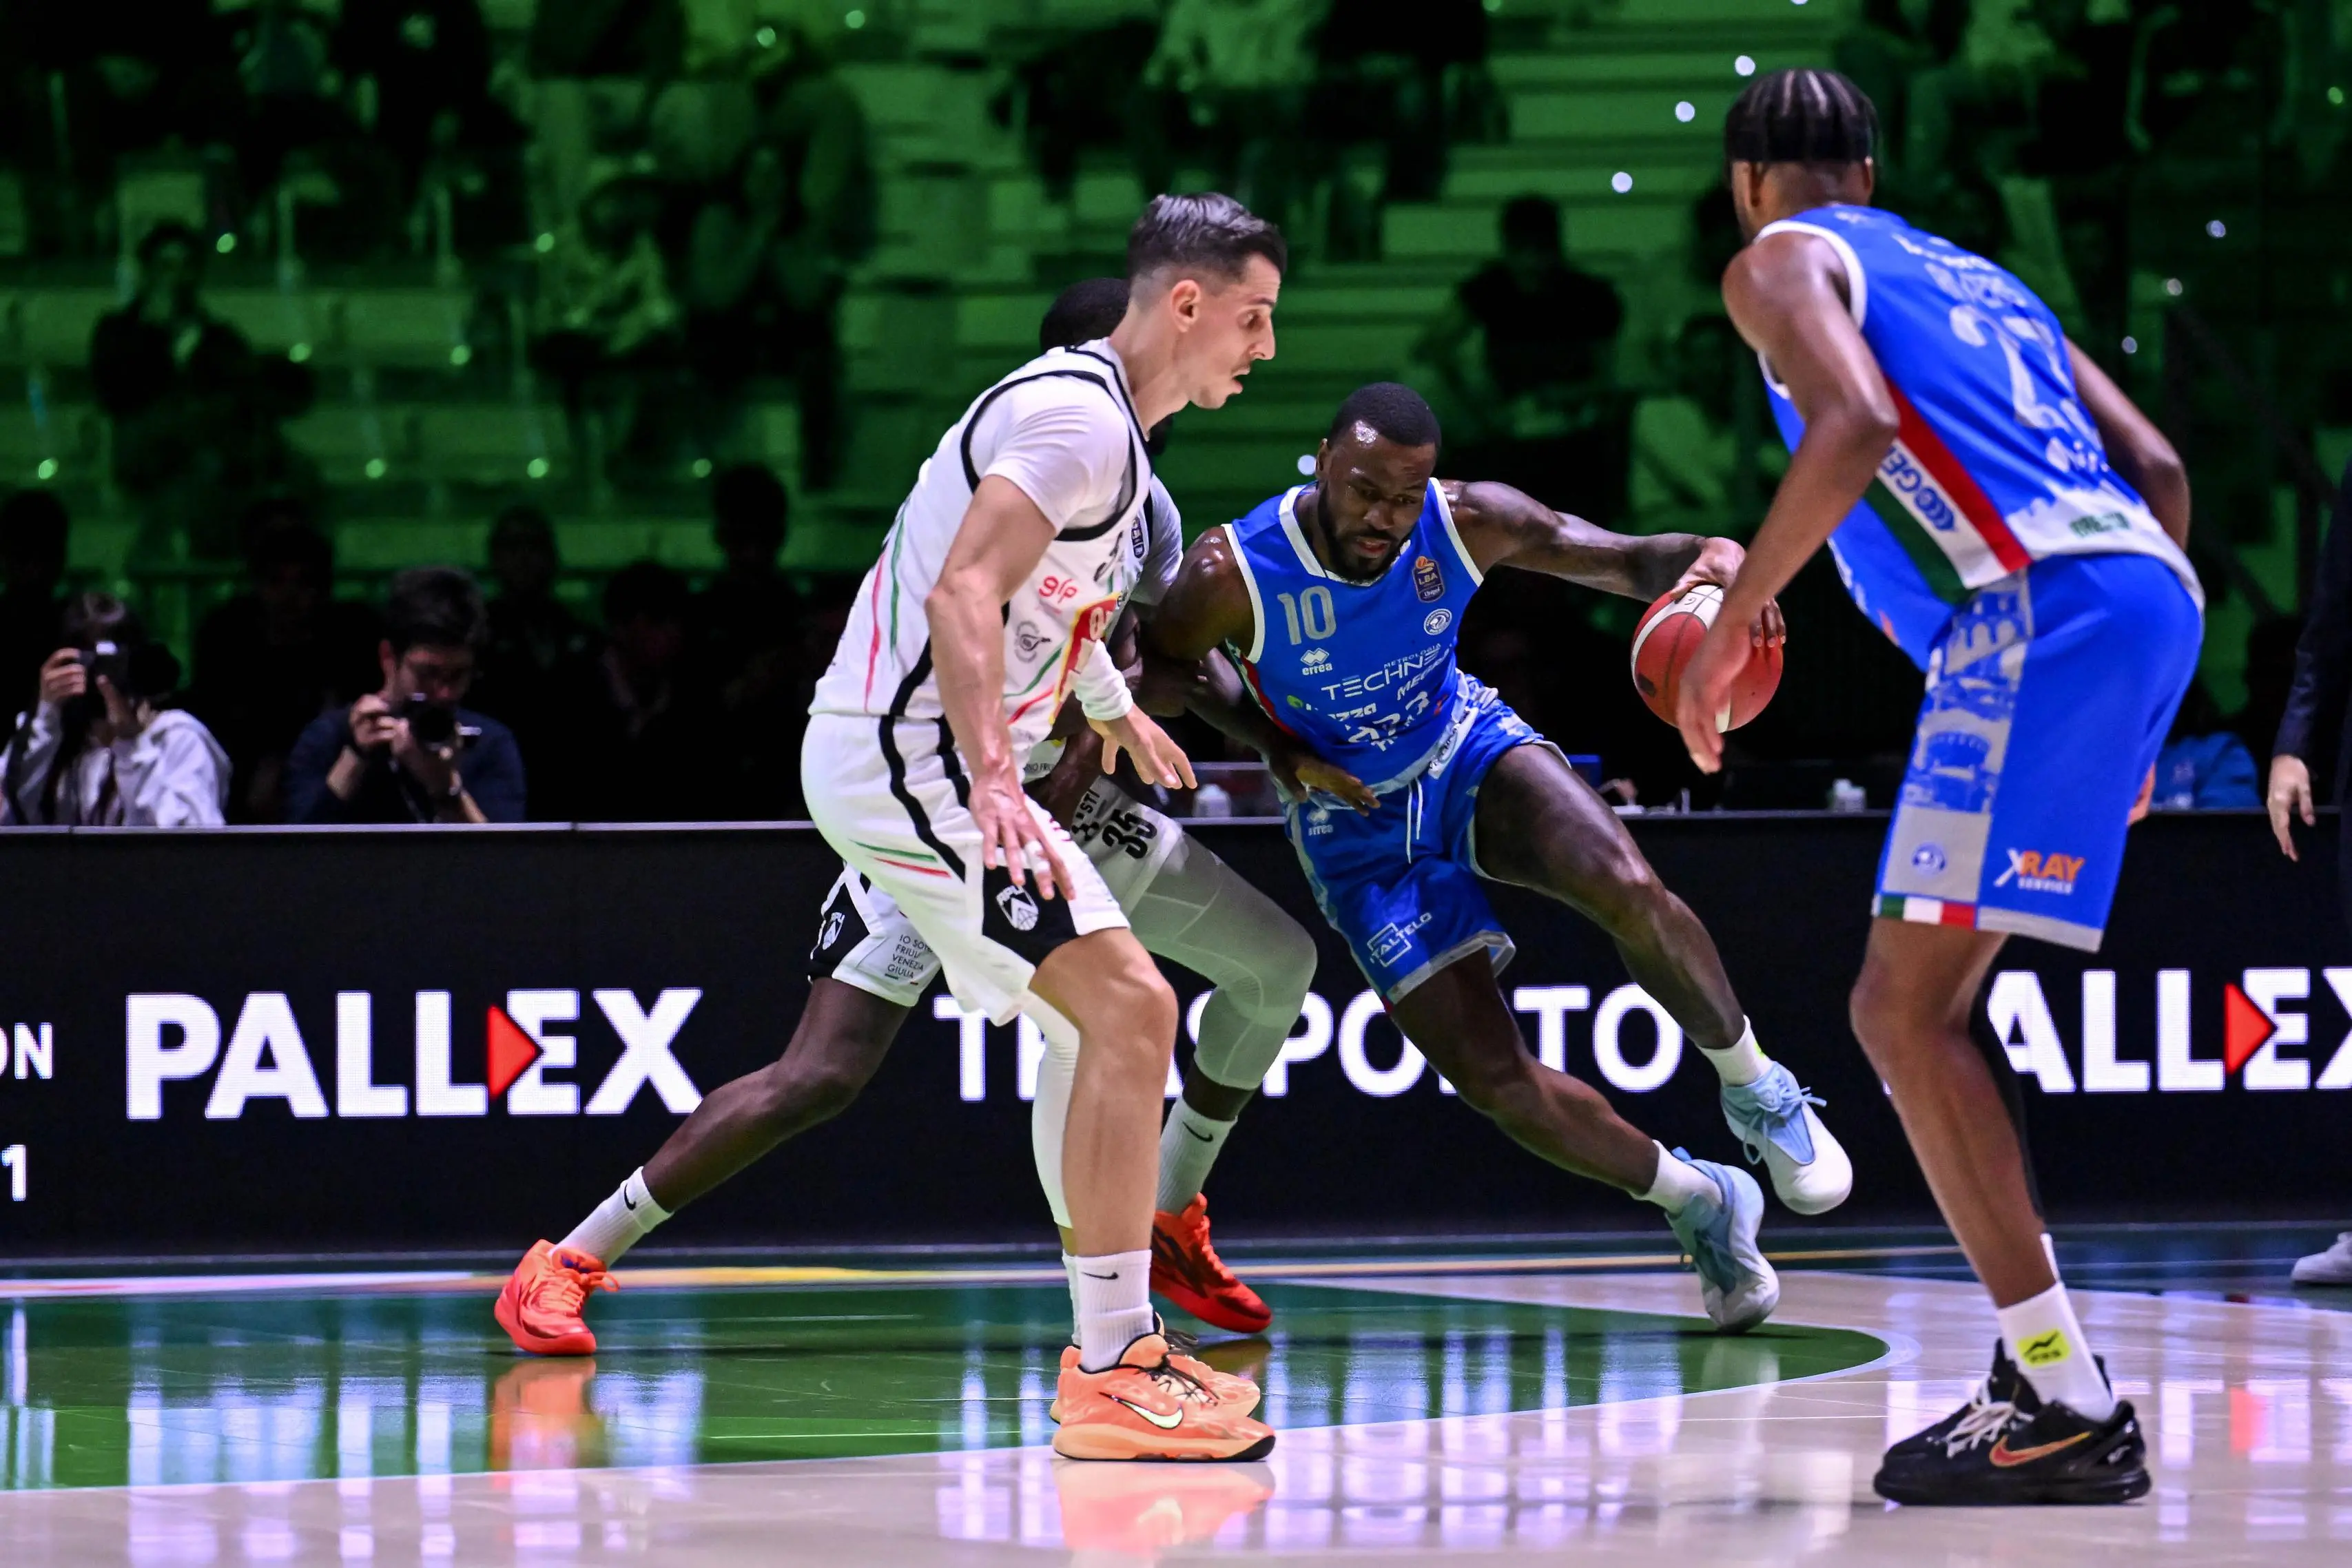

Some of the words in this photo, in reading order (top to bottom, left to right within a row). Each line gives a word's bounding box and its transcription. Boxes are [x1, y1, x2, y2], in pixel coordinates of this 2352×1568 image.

[1418, 572, 1438, 586] LBA
[1277, 586, 1337, 645] 10
[1321, 648, 1441, 701] TECHNE
[1384, 643, 1442, 669] METROLOGIA
[1102, 809, 1158, 859] 35
[1994, 847, 2085, 887] XRAY
[899, 934, 911, 944] IO
[0, 1022, 53, 1080] N
[126, 987, 703, 1120] PALLEX
[1987, 967, 2352, 1093] ALLE
